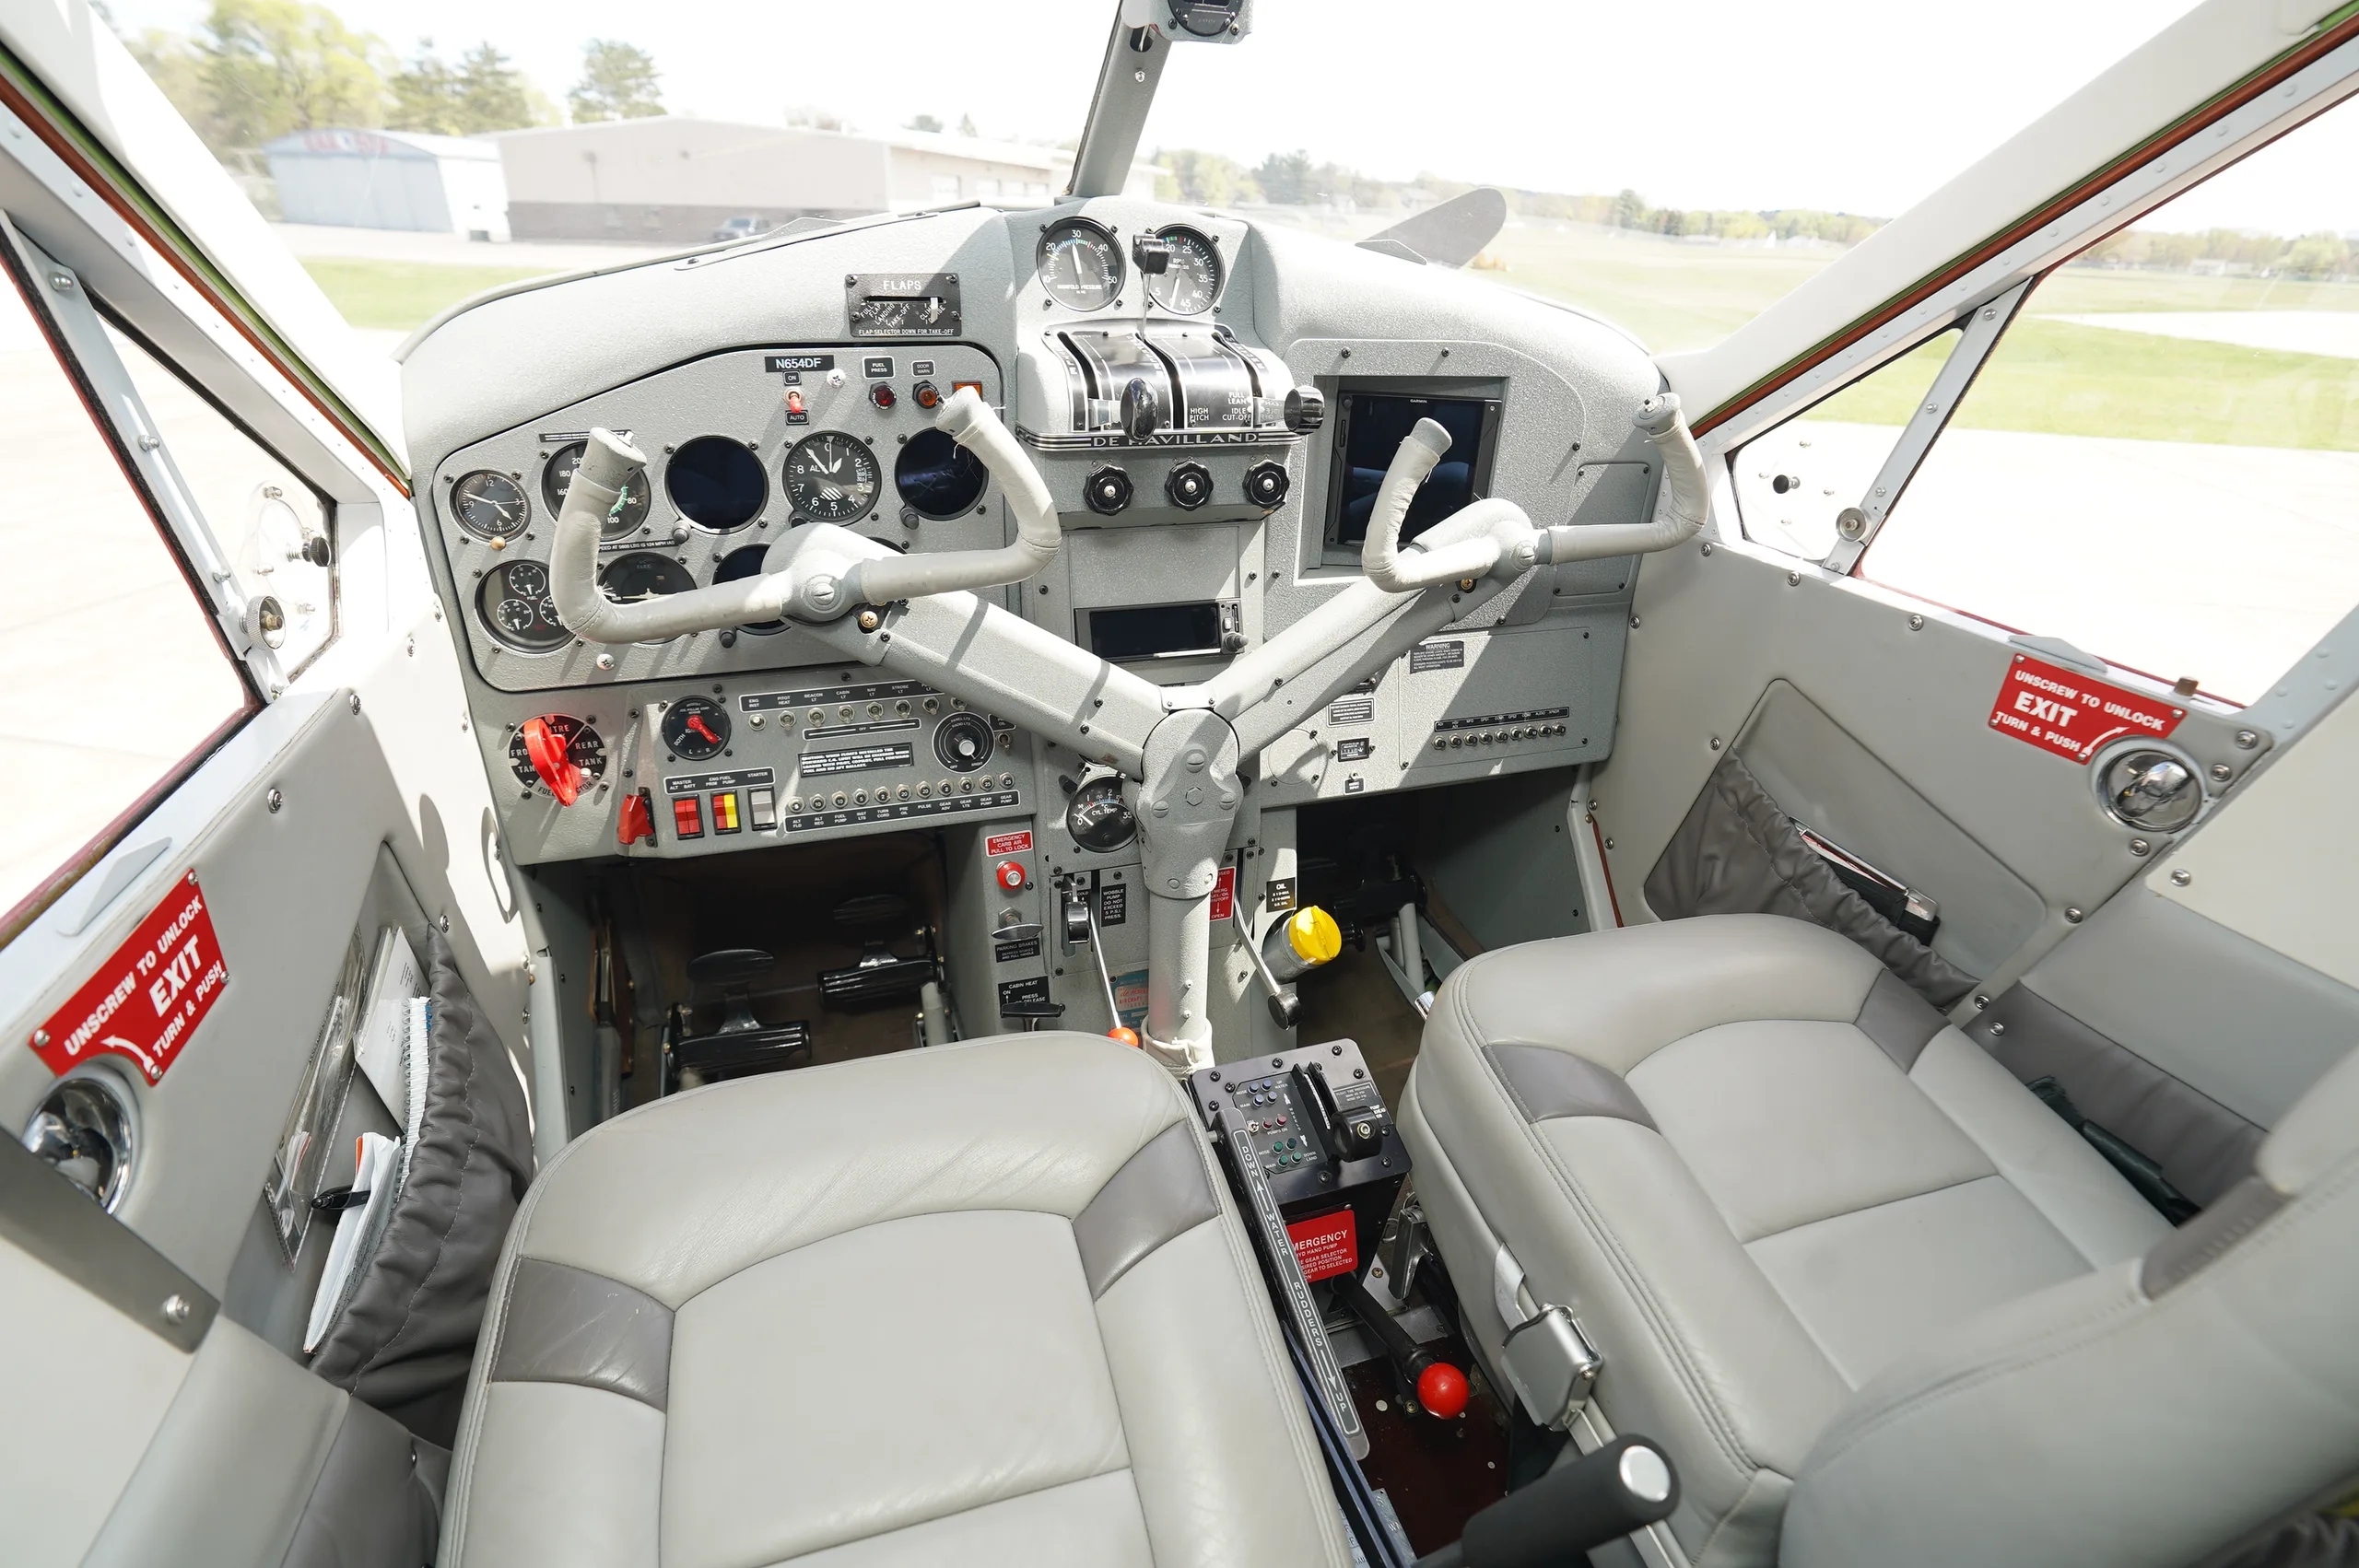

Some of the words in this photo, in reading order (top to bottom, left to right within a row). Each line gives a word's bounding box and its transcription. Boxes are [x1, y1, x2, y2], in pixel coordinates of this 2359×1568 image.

[1072, 229, 1082, 239] 30
[1046, 242, 1057, 251] 20
[1097, 243, 1109, 252] 40
[1166, 244, 1176, 252] 20
[1182, 245, 1192, 254] 25
[1193, 258, 1204, 266] 30
[1108, 275, 1118, 285] 50
[1198, 275, 1209, 283] 35
[884, 280, 921, 290] FLAPS
[1191, 290, 1203, 298] 40
[1180, 298, 1191, 308] 45
[860, 304, 874, 319] FULL
[869, 303, 883, 319] FLAP
[874, 303, 896, 325] LANDING
[887, 303, 911, 329] TAKE-OFF
[776, 358, 822, 369] N654DF
[1093, 437, 1119, 447] DE
[854, 458, 863, 467] 2
[797, 465, 804, 474] 8
[485, 479, 495, 487] 12
[797, 484, 804, 492] 7
[857, 483, 864, 491] 3
[557, 487, 568, 496] 160
[812, 497, 819, 507] 6
[848, 495, 856, 503] 4
[830, 502, 838, 511] 5
[607, 516, 619, 524] 100
[2015, 670, 2079, 700] UNSCREW
[2081, 693, 2101, 708] TO
[2104, 701, 2165, 731] UNLOCK
[2013, 690, 2079, 728] EXIT
[1996, 711, 2029, 731] TURN
[2030, 725, 2042, 737] &
[2045, 731, 2082, 753] PUSH
[673, 732, 687, 746] BOTH
[574, 740, 599, 751] REAR
[511, 747, 528, 757] FRO
[579, 757, 603, 767] TANK
[517, 764, 536, 774] TAN
[576, 781, 593, 794] CTOR
[1077, 818, 1084, 826] 0
[992, 834, 1026, 843] EMERGENCY
[1018, 940, 1039, 948] BRAKES
[64, 971, 137, 1057] UNSCREW
[136, 950, 158, 977] TO
[157, 895, 204, 954] UNLOCK
[148, 933, 202, 1018] EXIT
[152, 1011, 186, 1059] TURN
[185, 999, 196, 1017] &
[195, 959, 223, 1002] PUSH
[1294, 1230, 1348, 1251] MERGENCY
[1307, 1246, 1322, 1255] HAND
[1320, 1248, 1348, 1258] SELECTOR
[1318, 1255, 1343, 1265] POSITION
[1304, 1267, 1319, 1275] GEAR
[1326, 1258, 1353, 1269] SELECTED
[1241, 1145, 1259, 1176] DOWN
[1266, 1213, 1288, 1256] WATER
[1293, 1281, 1323, 1347] RUDDERS
[1335, 1391, 1347, 1413] UP
